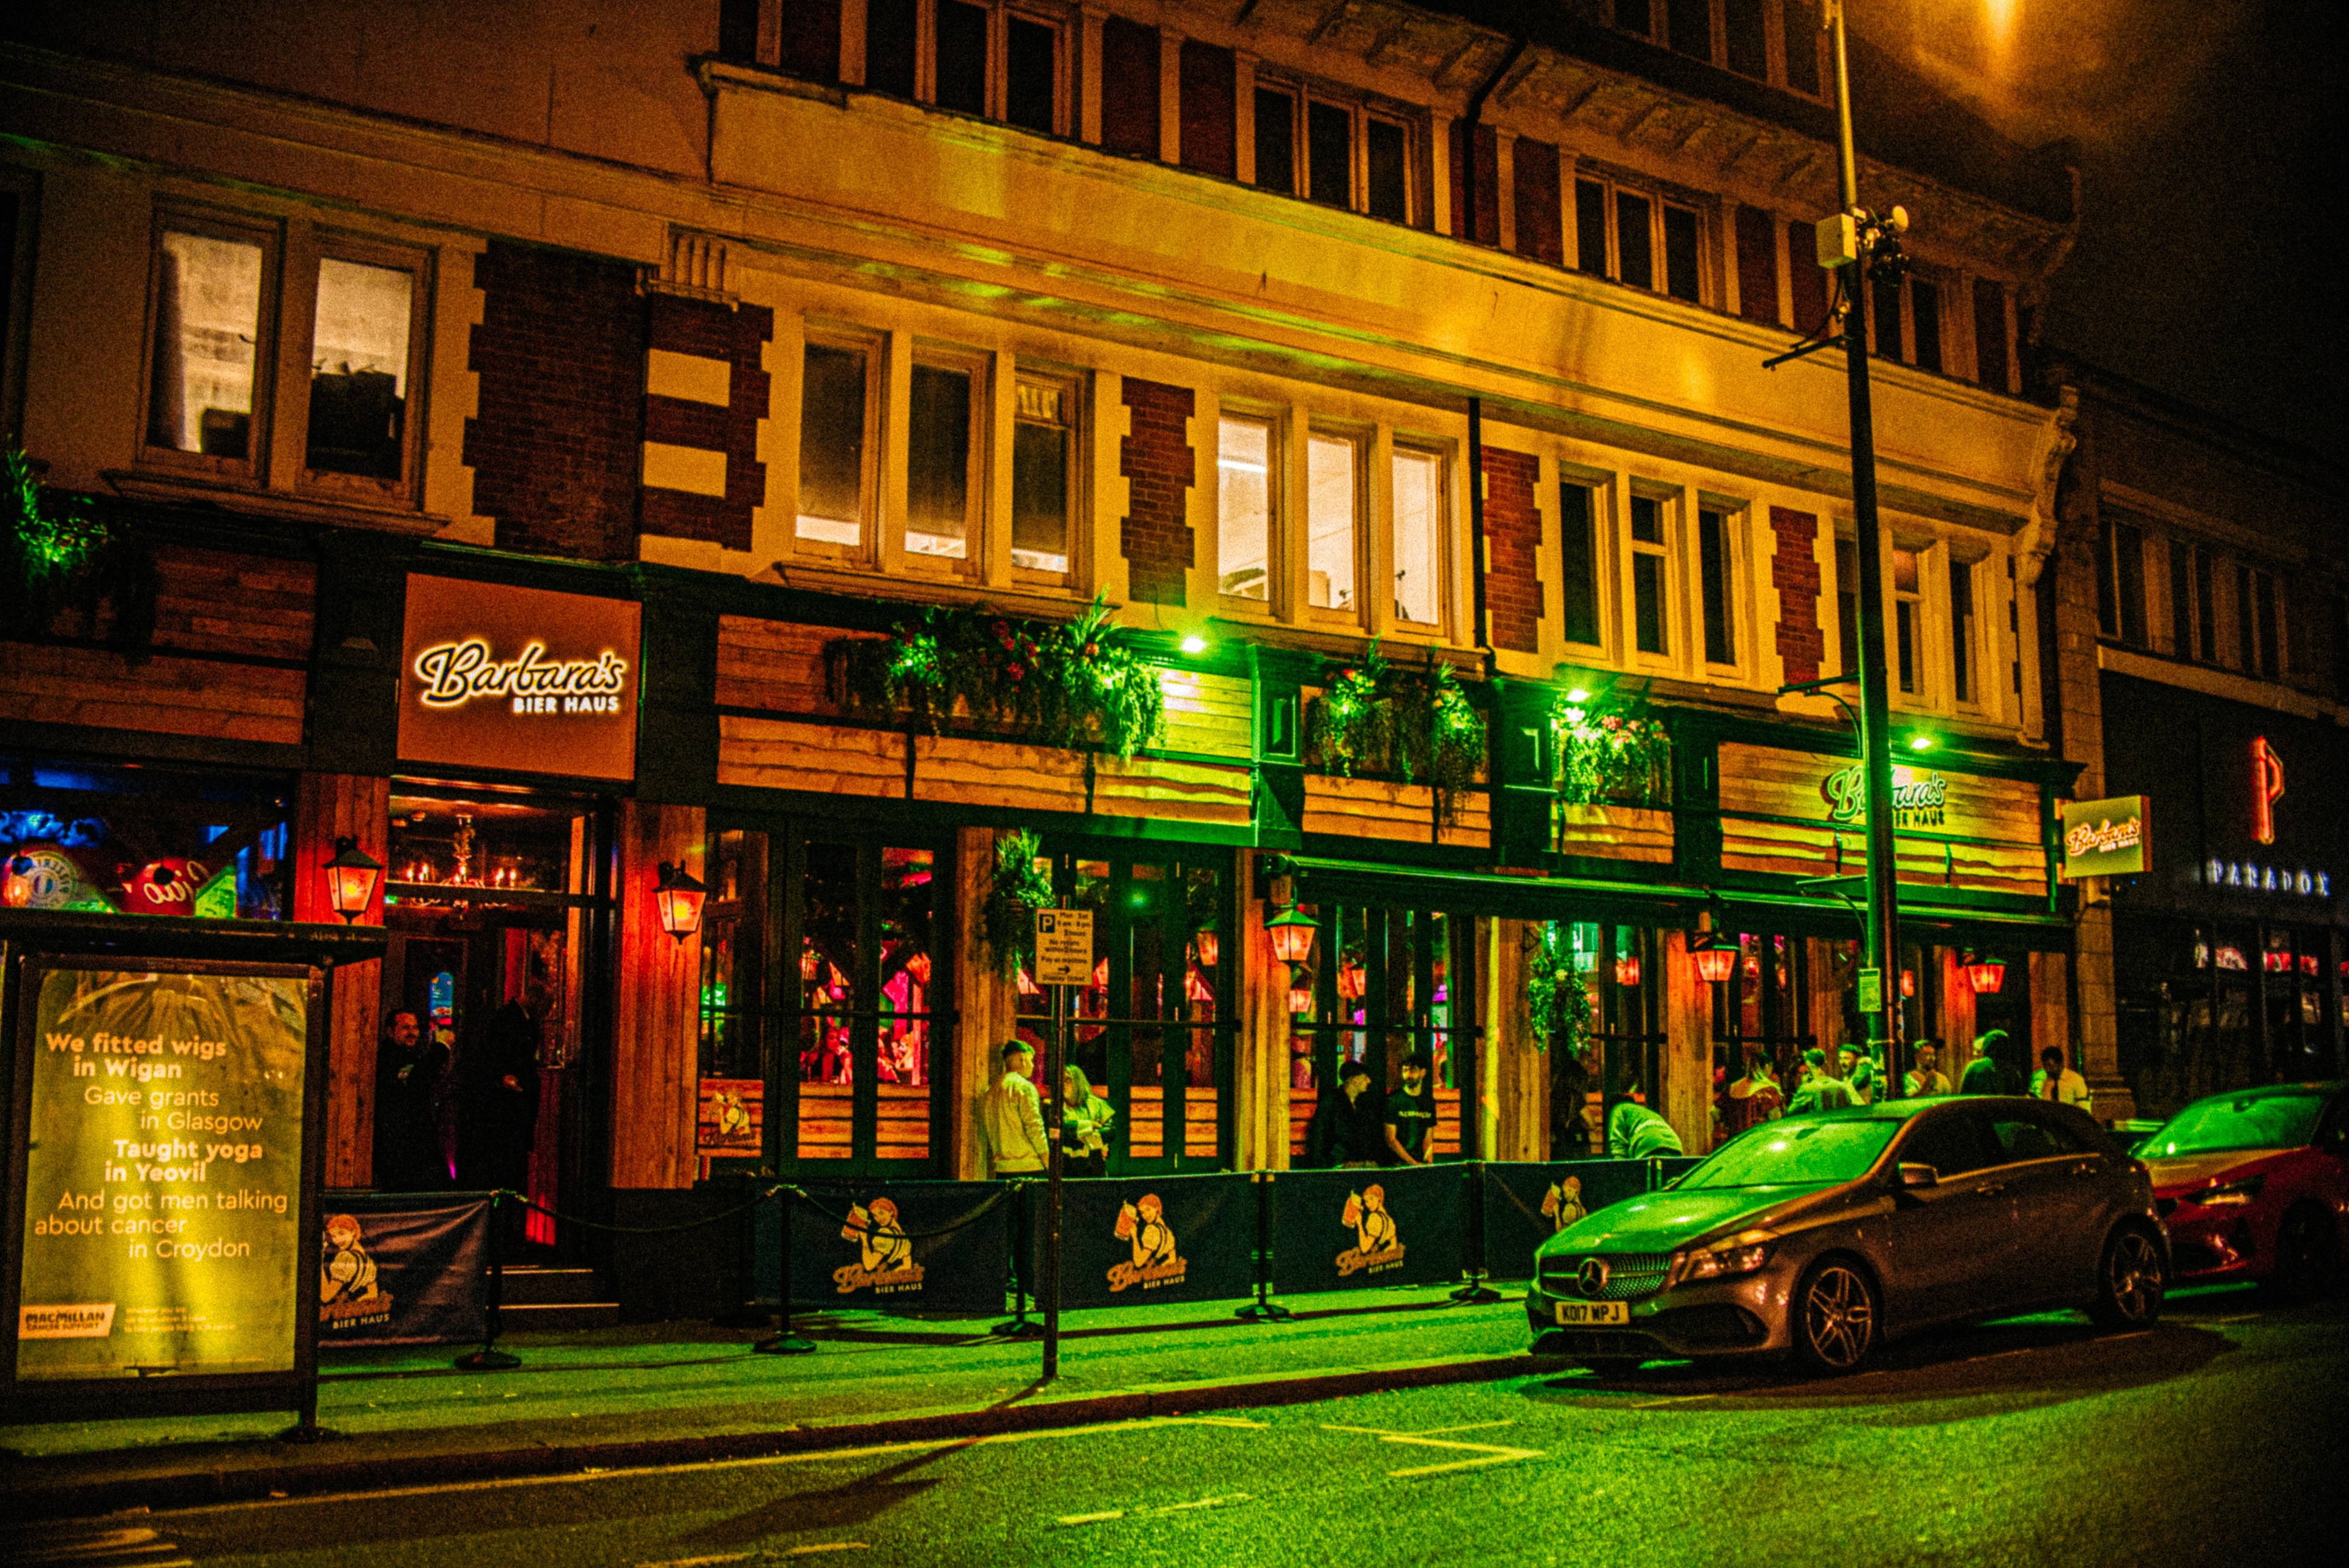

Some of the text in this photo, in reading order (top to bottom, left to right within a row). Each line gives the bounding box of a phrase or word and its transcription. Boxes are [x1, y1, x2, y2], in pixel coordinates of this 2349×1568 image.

[415, 639, 626, 707] Barbara's
[513, 696, 618, 712] BIER HAUS
[1914, 811, 1945, 826] HAUS
[2065, 816, 2141, 856] Barbara's
[2206, 858, 2330, 897] PARADOX
[1042, 916, 1053, 932] P
[46, 1032, 226, 1060] We fitted wigs
[73, 1055, 182, 1082] in Wigan
[84, 1087, 219, 1110] Gave grants
[140, 1110, 263, 1134] in Glasgow
[113, 1139, 263, 1163] Taught yoga
[105, 1160, 206, 1182] in Yeovil
[58, 1189, 288, 1214] And got men talking
[35, 1214, 187, 1235] about cancer
[128, 1238, 250, 1263] in Croydon
[898, 1283, 922, 1292] HAUS
[26, 1312, 105, 1323] MACMILLAN
[333, 1313, 390, 1329] BIER HAUS
